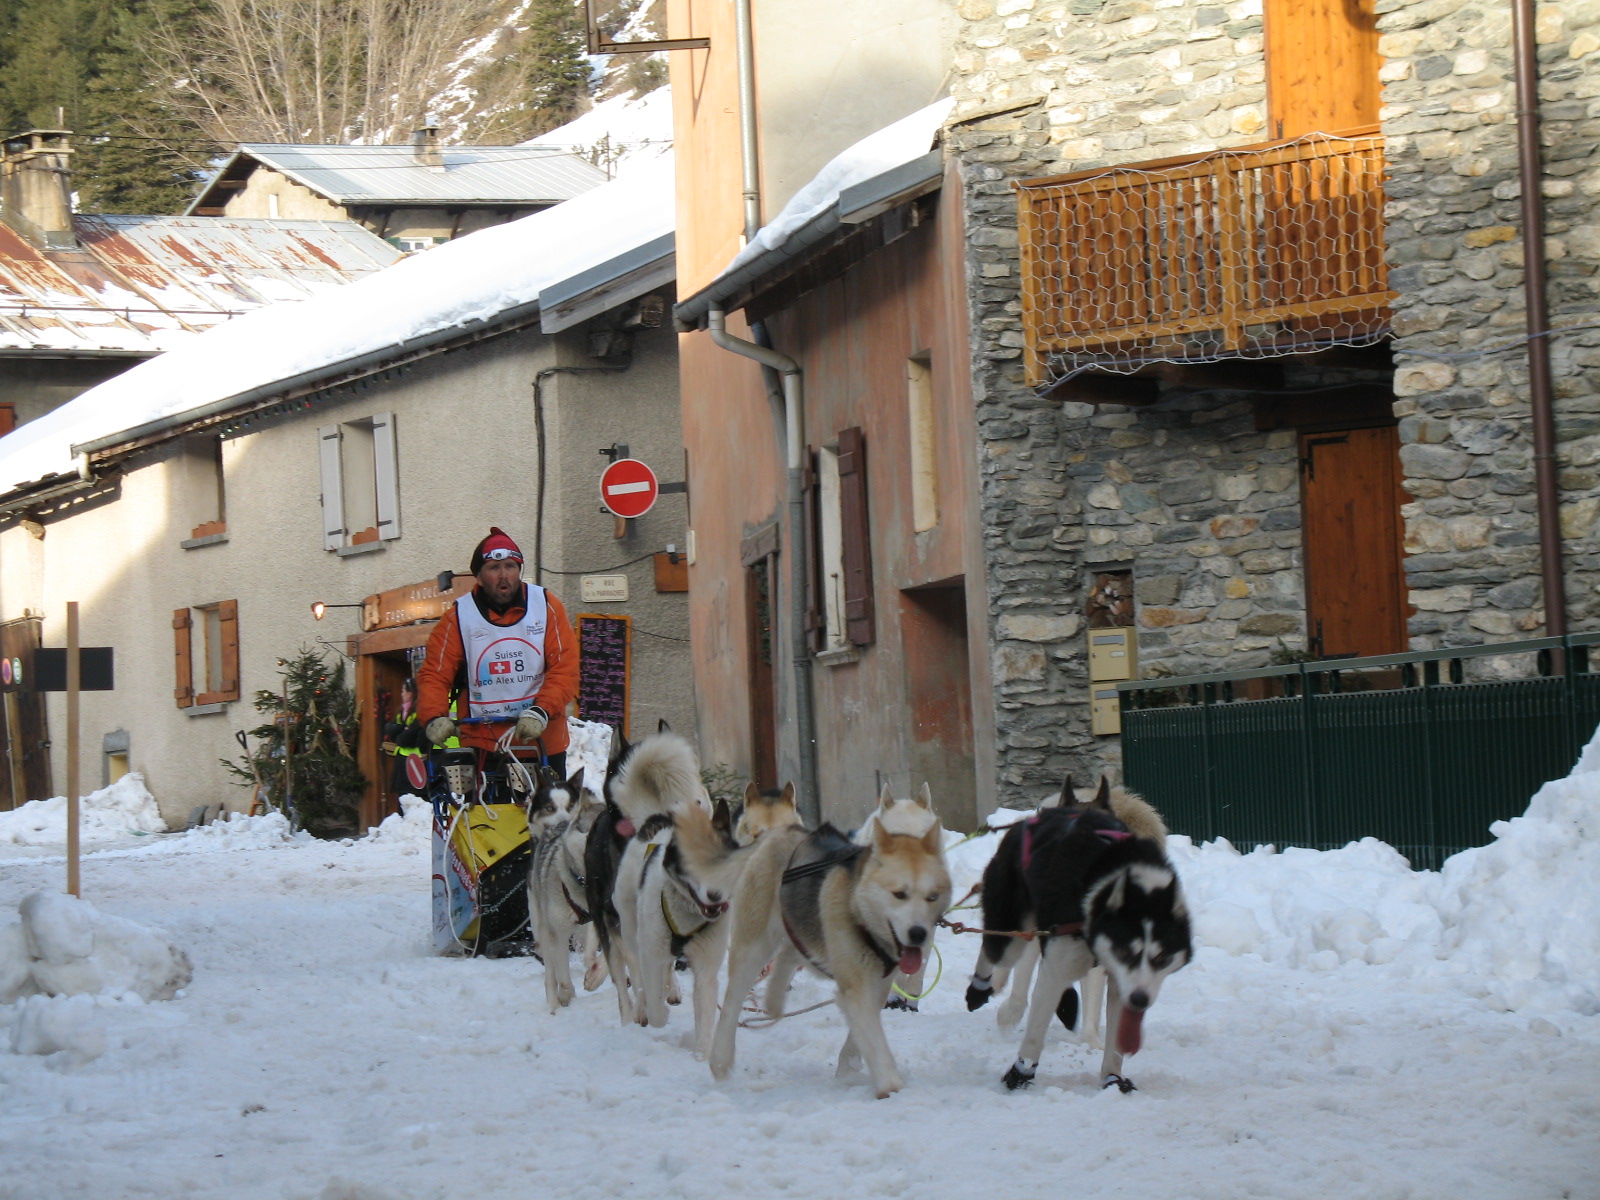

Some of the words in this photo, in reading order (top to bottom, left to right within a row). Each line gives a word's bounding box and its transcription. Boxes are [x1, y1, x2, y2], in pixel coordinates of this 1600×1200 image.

[495, 651, 523, 660] Suisse
[514, 660, 524, 672] 8
[496, 676, 514, 684] Alex
